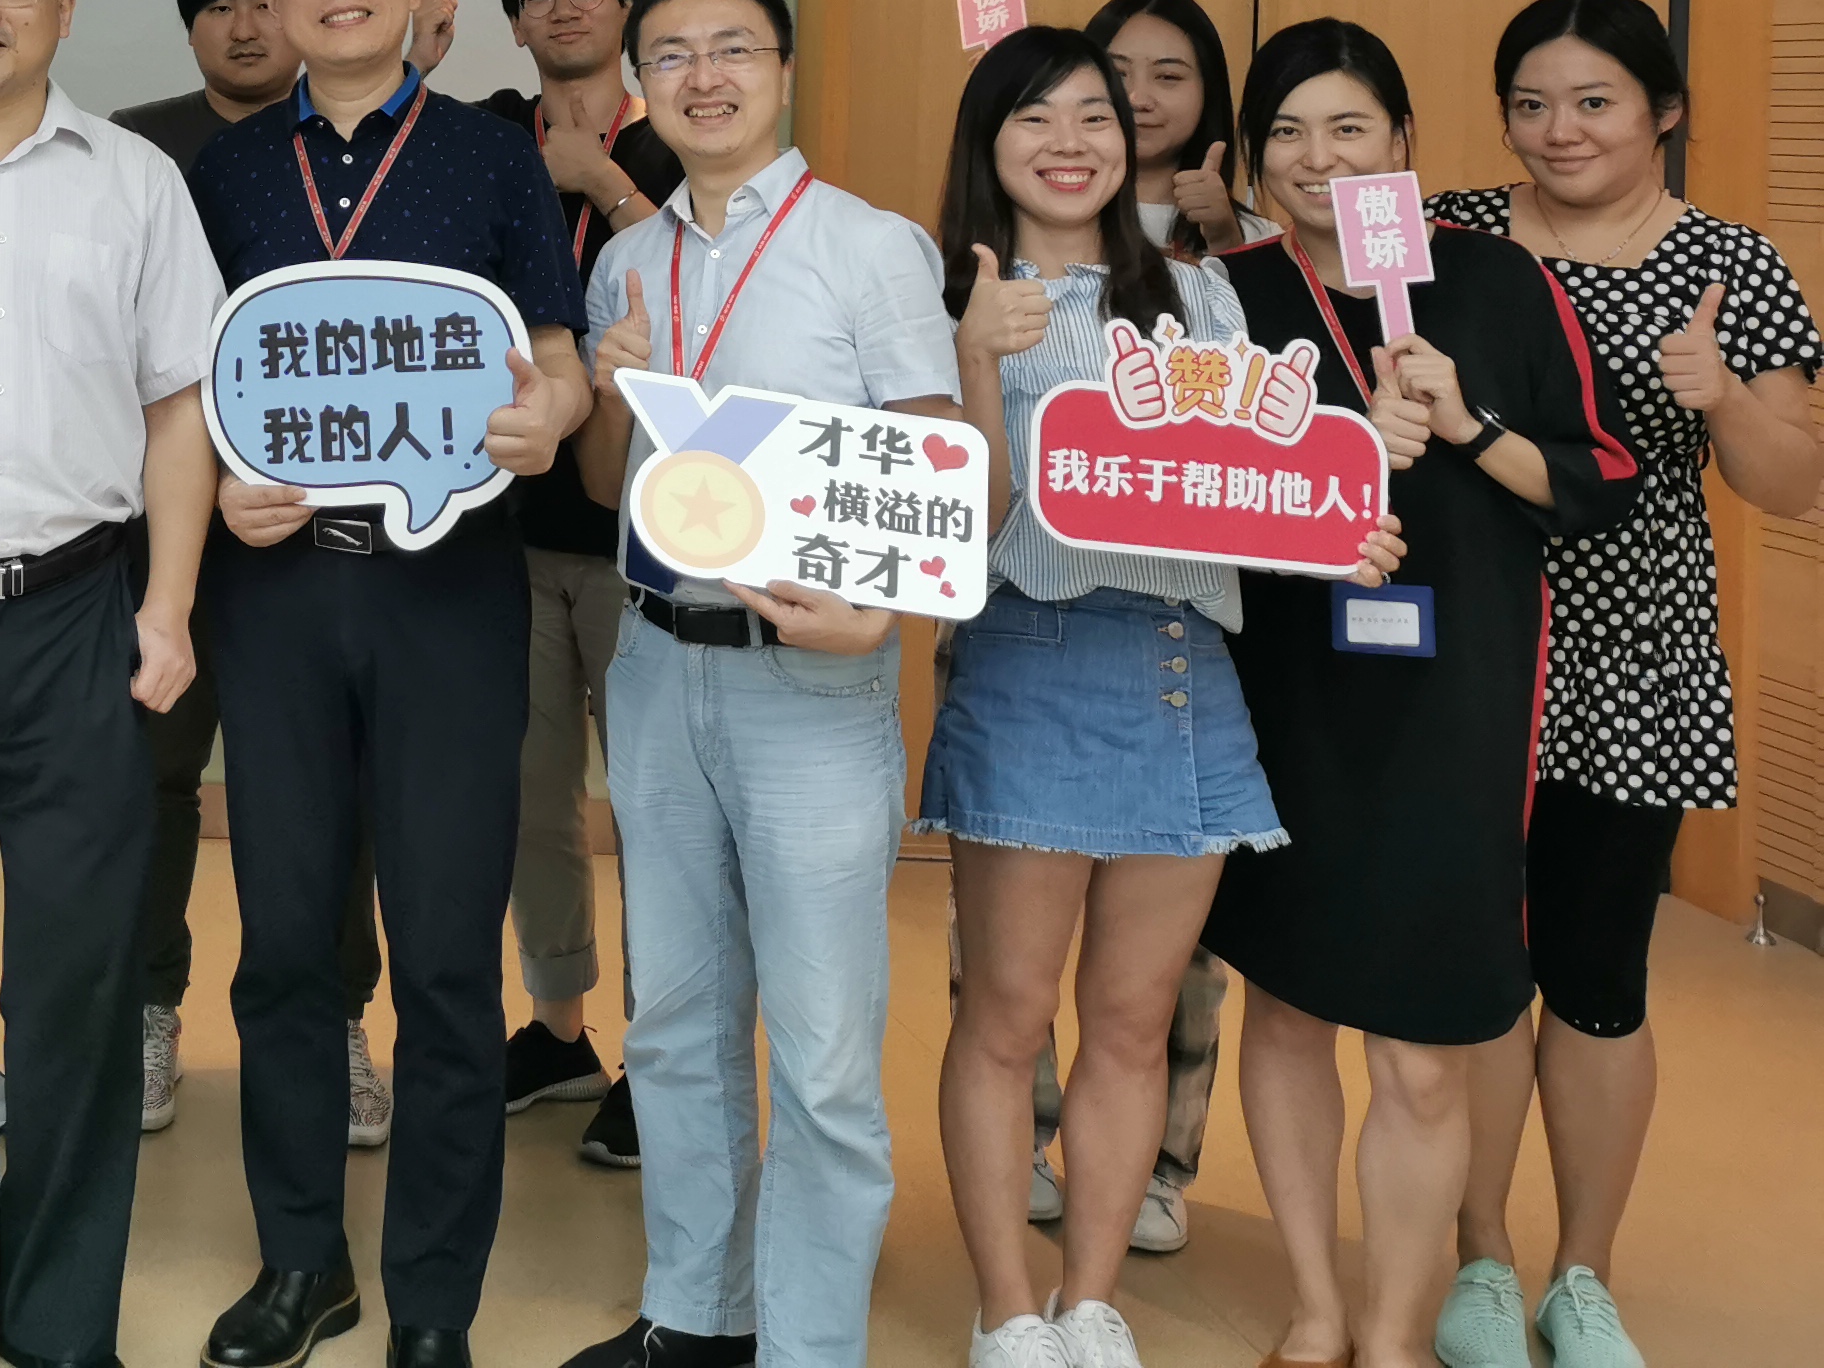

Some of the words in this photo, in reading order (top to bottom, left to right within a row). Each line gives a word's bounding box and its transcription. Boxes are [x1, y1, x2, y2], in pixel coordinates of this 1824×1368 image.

[1355, 185, 1408, 270] 傲娇
[259, 311, 486, 379] 我的地盘
[263, 401, 455, 465] 我的人!
[798, 416, 916, 475] 才华
[823, 478, 974, 543] 横溢的
[1046, 447, 1374, 522] 我乐于帮助他人!
[792, 533, 912, 599] 奇才
